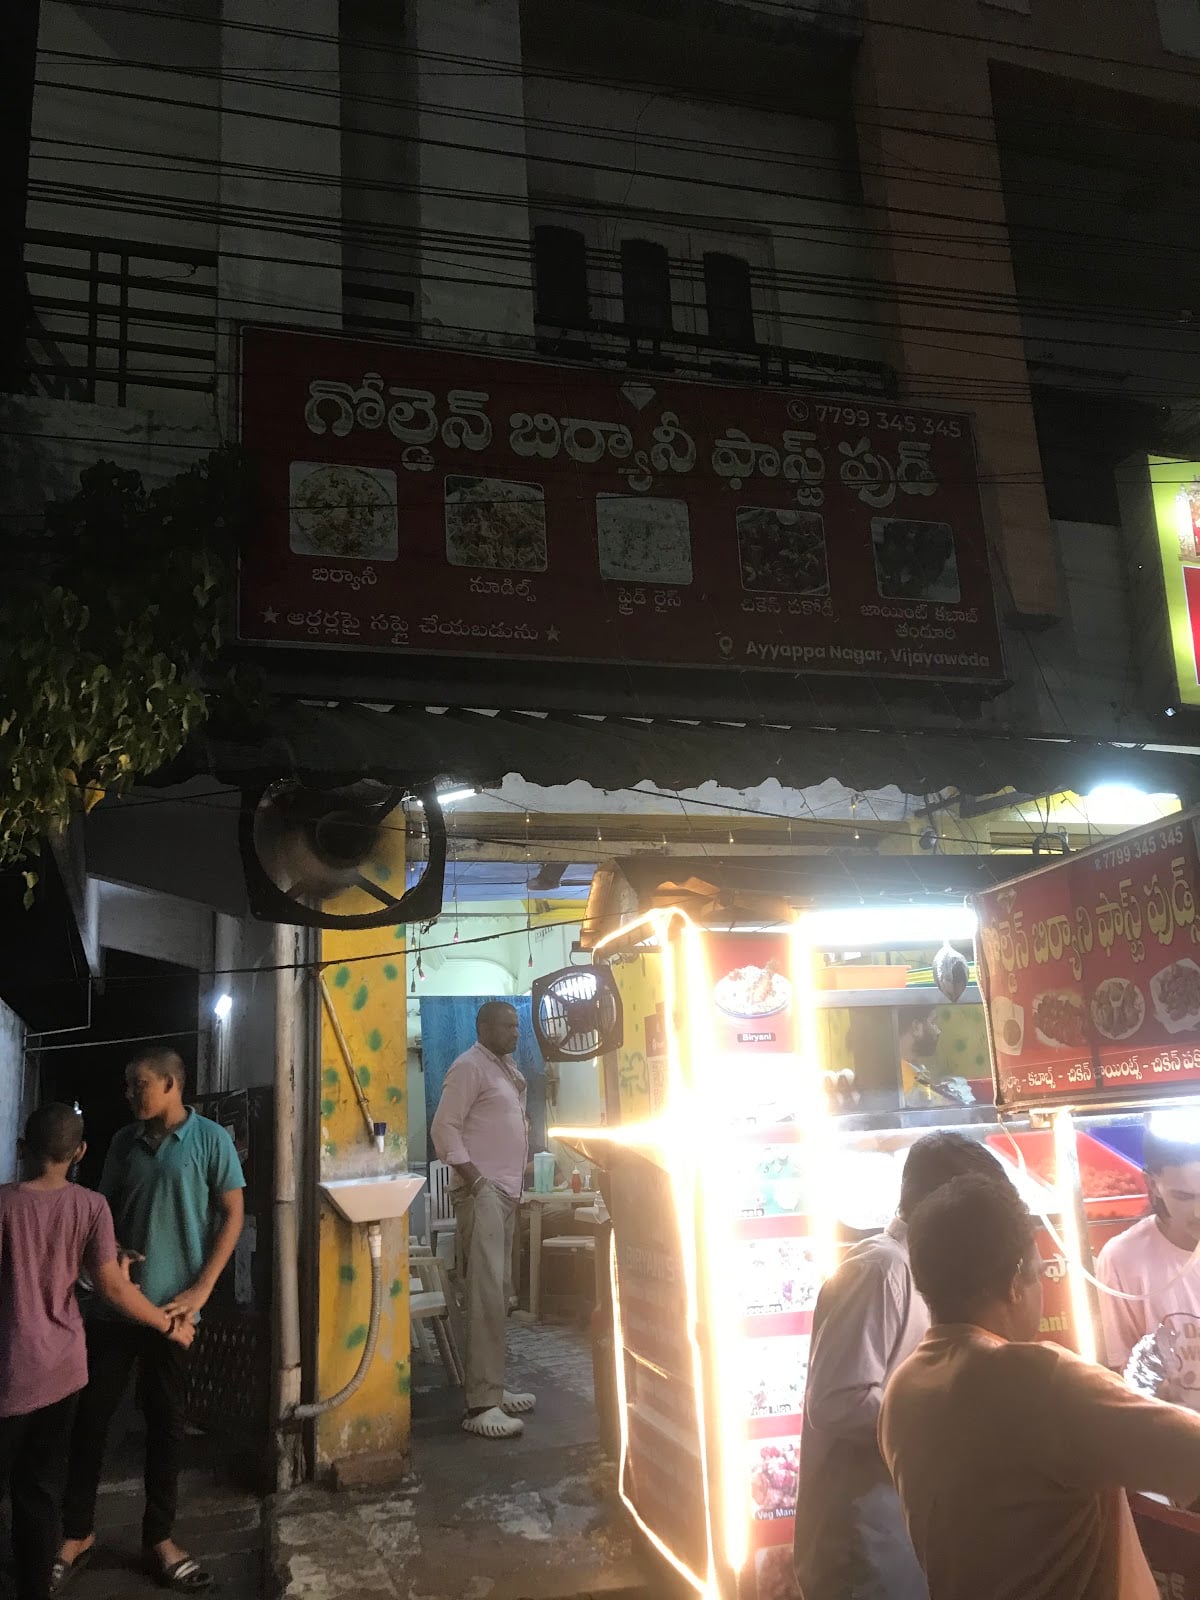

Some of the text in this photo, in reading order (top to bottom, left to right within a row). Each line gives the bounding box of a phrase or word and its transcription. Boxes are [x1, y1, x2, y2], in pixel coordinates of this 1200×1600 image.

[815, 404, 962, 438] 7799 345 345
[508, 411, 697, 492] బిర్యానీ
[311, 566, 377, 591] బిర్యానీ
[418, 614, 539, 641] చేయబడును
[745, 640, 990, 668] Ayyappa Nagar, Vijayawada
[1102, 825, 1185, 869] 7799 345 345
[742, 1032, 772, 1042] Biryani
